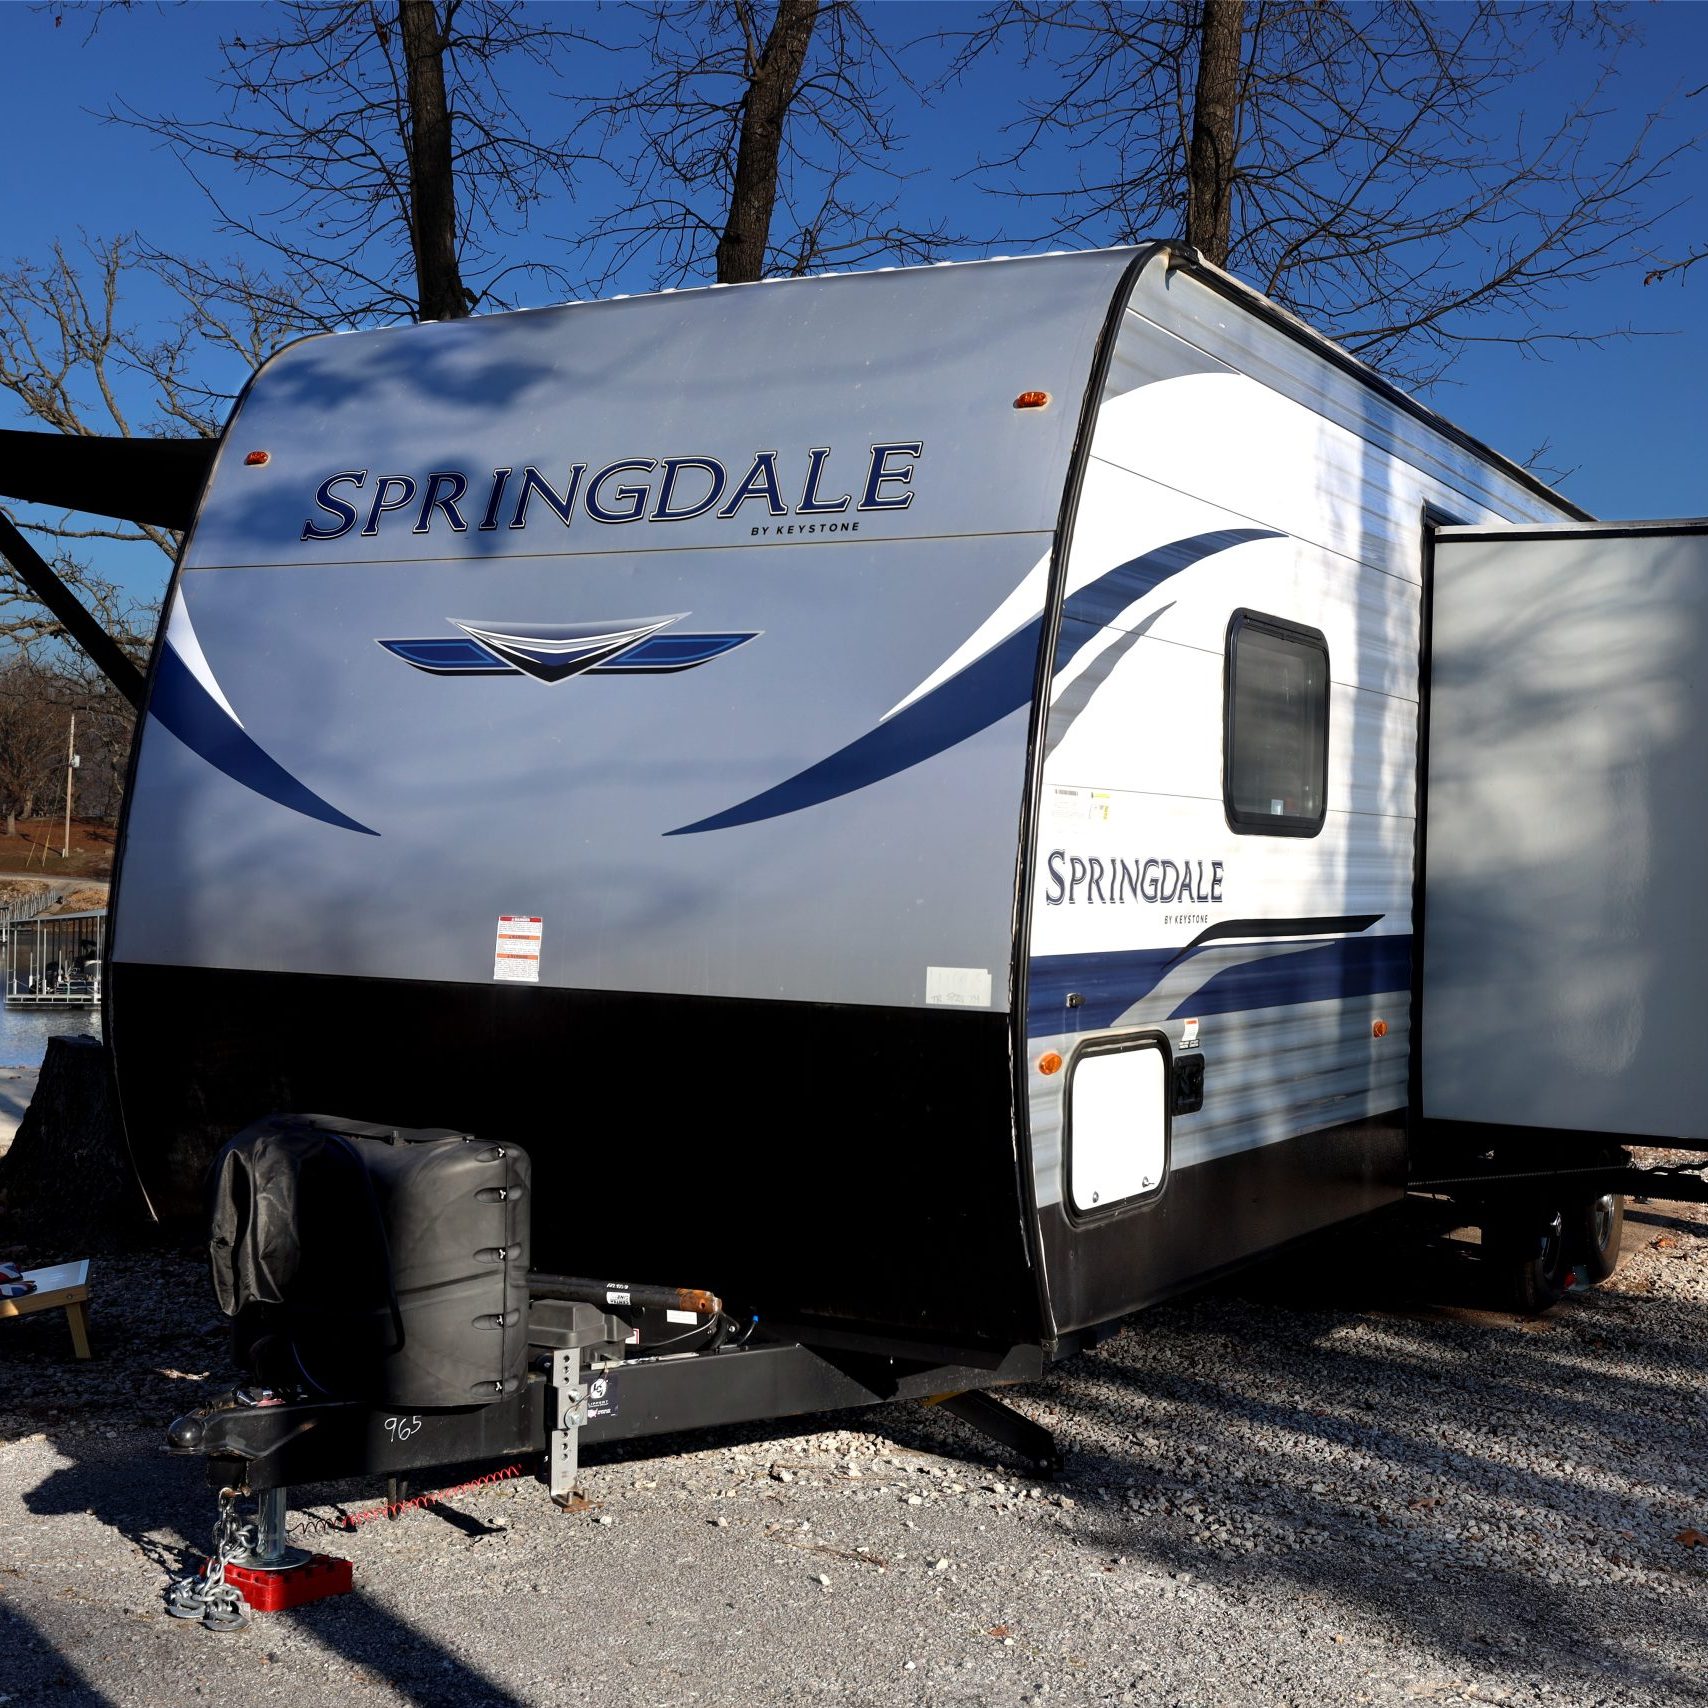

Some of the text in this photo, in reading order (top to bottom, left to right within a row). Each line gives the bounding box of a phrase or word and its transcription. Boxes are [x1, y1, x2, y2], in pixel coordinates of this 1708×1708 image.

[300, 441, 923, 541] SPRINGDALE
[751, 522, 860, 536] BY KEYSTONE
[1046, 848, 1224, 906] SPRINGDALE
[1164, 914, 1208, 925] BY KEYSTONE
[384, 1415, 422, 1443] 965
